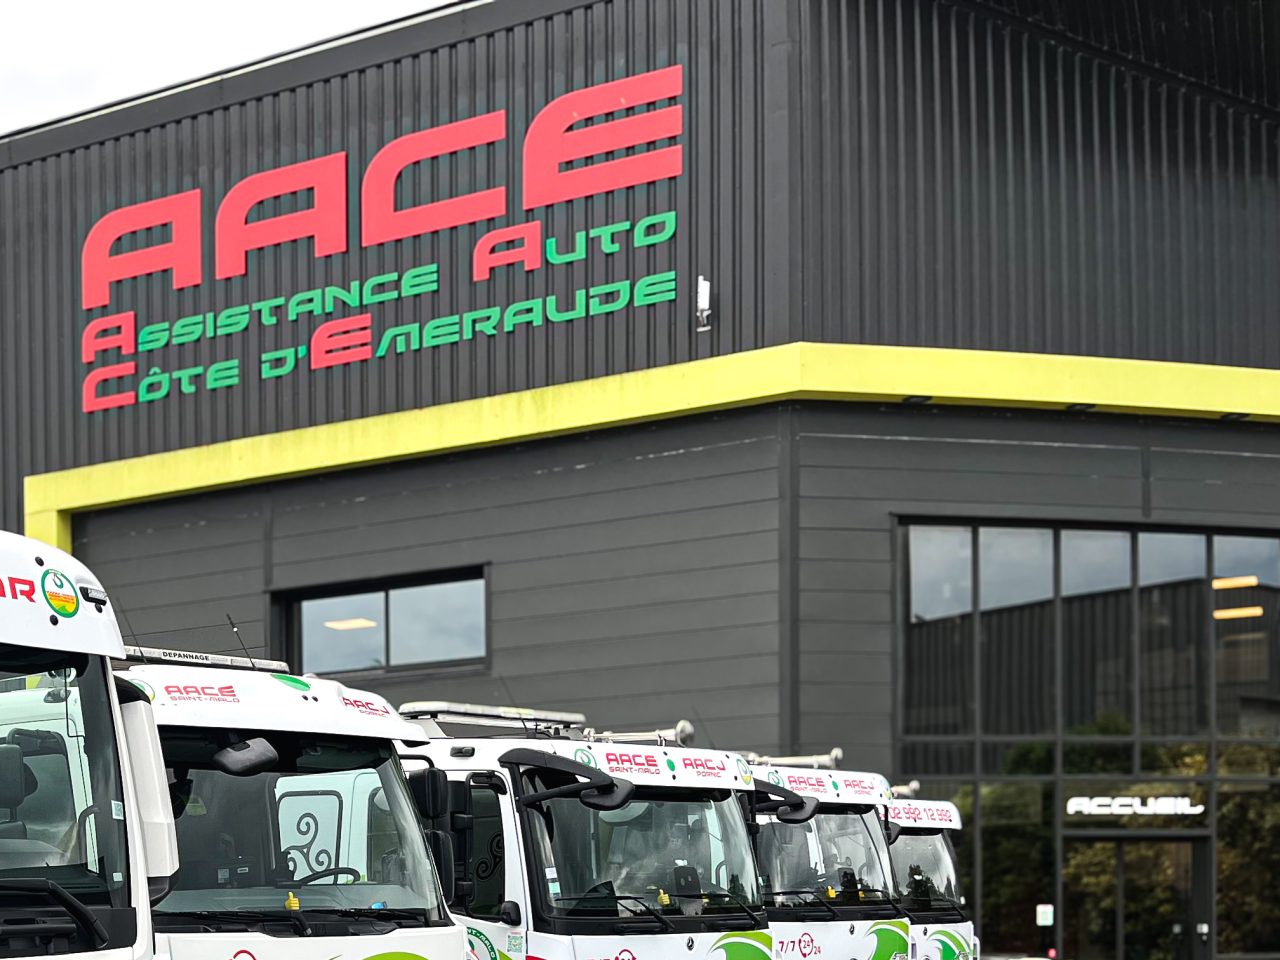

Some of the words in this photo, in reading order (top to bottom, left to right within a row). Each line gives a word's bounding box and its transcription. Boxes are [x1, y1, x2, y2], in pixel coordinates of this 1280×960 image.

[81, 64, 683, 311] AACE
[81, 263, 439, 364] ASSISTANCE
[472, 210, 677, 282] AUTO
[81, 359, 241, 413] CÔTE
[260, 270, 677, 380] D'EMERAUDE
[161, 651, 210, 661] DEPANNAGE
[163, 685, 237, 697] AACE
[605, 752, 658, 768] AACE
[681, 757, 726, 772] AACJ
[608, 765, 661, 775] SAINT-MALO
[787, 775, 826, 788] AACE
[1066, 796, 1206, 815] ACCUEIL
[778, 940, 796, 954] 7/7
